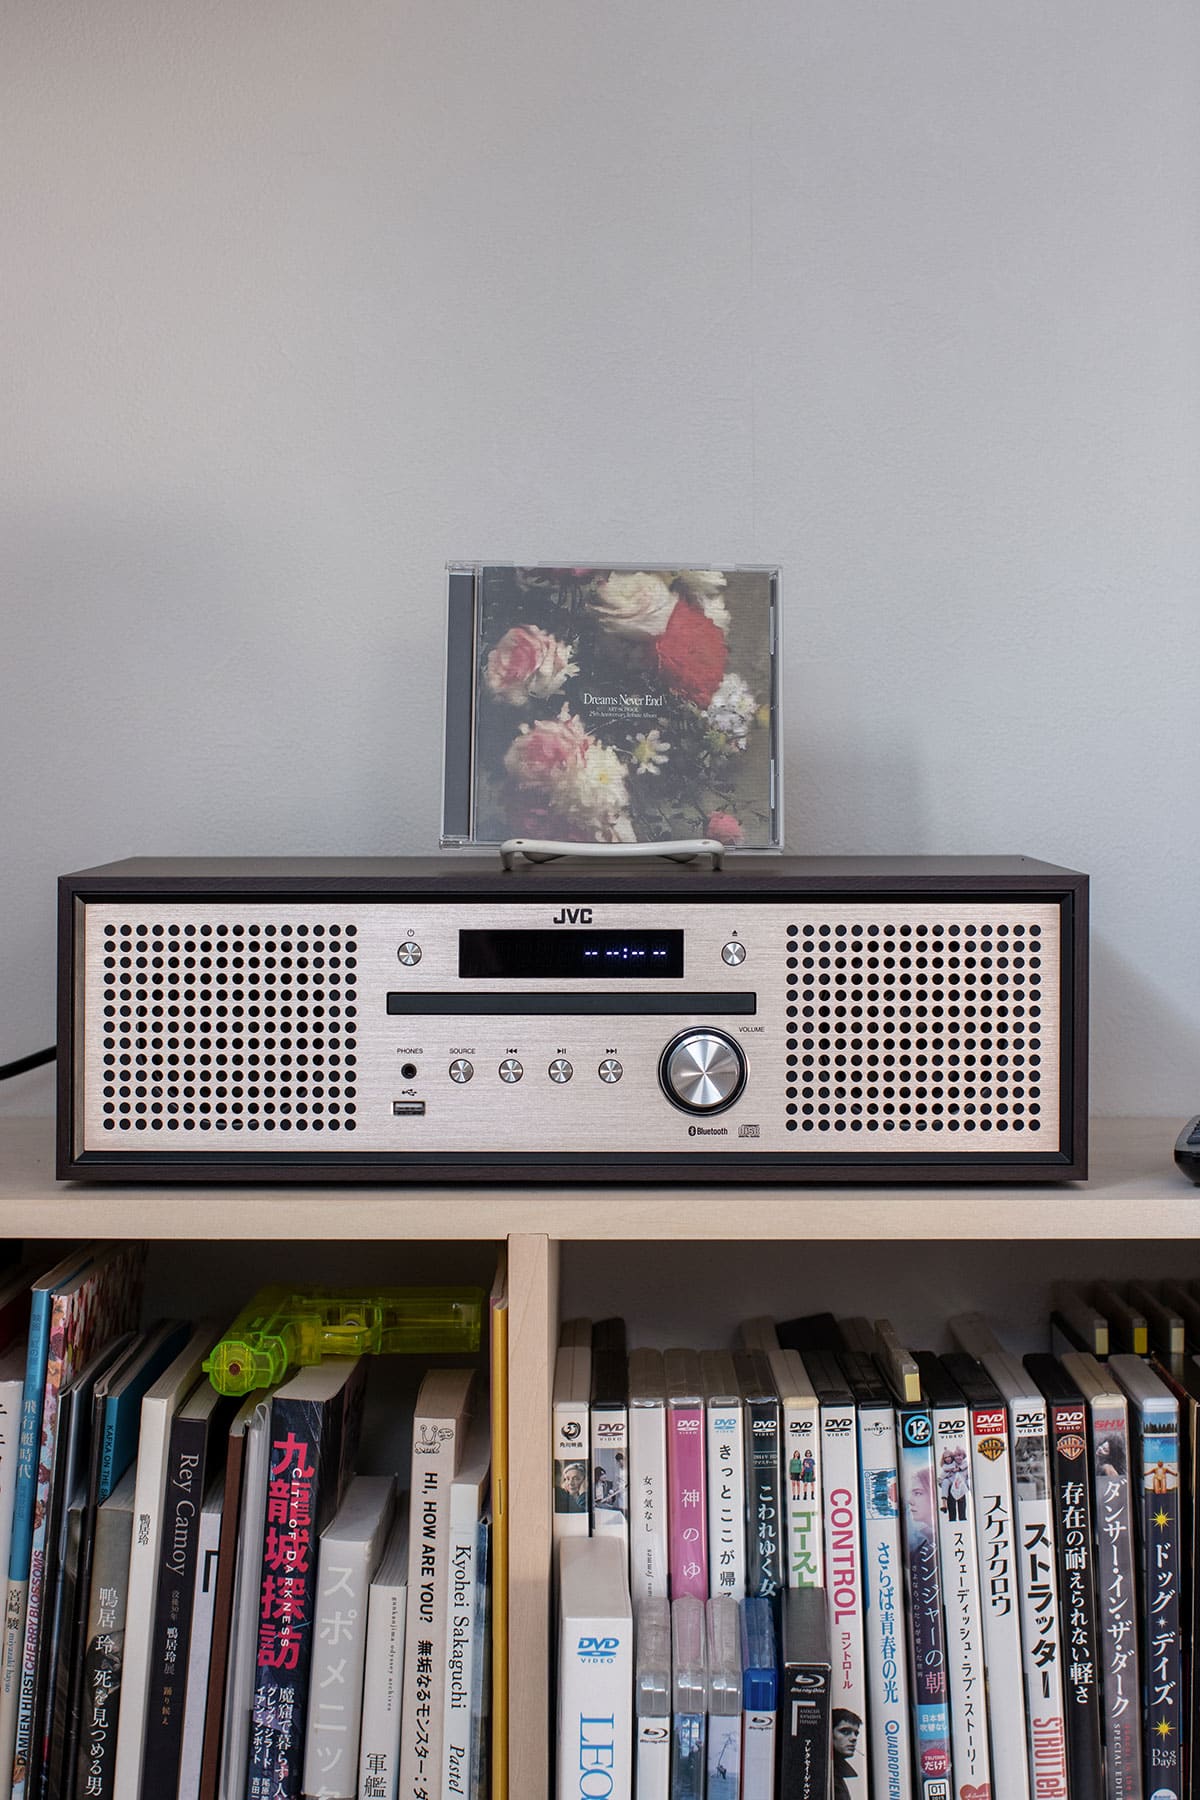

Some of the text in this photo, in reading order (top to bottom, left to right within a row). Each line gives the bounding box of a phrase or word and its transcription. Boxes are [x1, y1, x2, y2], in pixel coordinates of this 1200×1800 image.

[584, 692, 663, 706] Dreams Never End
[553, 908, 593, 924] JVC
[697, 1127, 728, 1136] Bluetooth
[598, 1424, 625, 1432] DVD
[753, 1420, 776, 1428] DVD
[825, 1419, 852, 1428] DVD
[938, 1420, 966, 1429] DVD
[976, 1414, 1004, 1422] DVD
[1016, 1413, 1045, 1422] DVD
[1056, 1412, 1083, 1420] DVD
[19, 1400, 36, 1478] 飛行艇時代
[104, 1425, 114, 1453] KAFKA
[102, 1470, 110, 1486] THE
[103, 1456, 112, 1468] ON
[422, 1472, 438, 1494] HI,
[166, 1454, 199, 1576] Rey Camoy
[422, 1502, 436, 1539] HOW
[643, 1476, 654, 1532] 女っ気なし
[258, 1432, 315, 1670] 九龍城探訪
[682, 1489, 700, 1580] 神のゆ
[758, 1486, 776, 1597] こわれゆく女
[830, 1488, 856, 1624] CONTROL
[280, 1468, 302, 1647] CITY OF DARKNESS
[422, 1544, 436, 1576] ARE
[984, 1496, 1011, 1617] スケアクロウ
[420, 1582, 434, 1623] YOU?
[1024, 1524, 1056, 1699] ストラッター
[1062, 1482, 1094, 1704] 存在の耐えられない軽さ
[1103, 1478, 1134, 1718] ダンサー・イン・ザ・ダーク
[878, 1542, 899, 1704] さらば青春の光
[920, 1542, 945, 1694] ジンジャーの朝
[7, 1632, 17, 1668] miyazaki
[16, 1550, 43, 1766] DAMIEN HIRST CHERRY BLOSSOMS
[578, 1638, 620, 1650] DVD
[841, 1632, 853, 1690] コントロール
[954, 1533, 976, 1776] スウェーディッシュ・ラブ・ストーリー
[448, 1545, 471, 1794] Kyohei Sakaguchi Pastel
[84, 1588, 118, 1797] 鴨居玲 死を見つめる男
[253, 1686, 266, 1764] イアン・ランボット
[264, 1686, 277, 1768] グレッグ・ジラード
[273, 1687, 294, 1800] 魔窟で暮らす人
[1114, 1724, 1122, 1766] SPECIAL
[580, 1712, 614, 1800] LEO
[924, 1761, 946, 1770] だけ!
[1152, 1748, 1176, 1759] Dog
[1152, 1758, 1176, 1768] Days
[364, 1753, 387, 1798] 軍艦
[931, 1786, 942, 1794] 01
